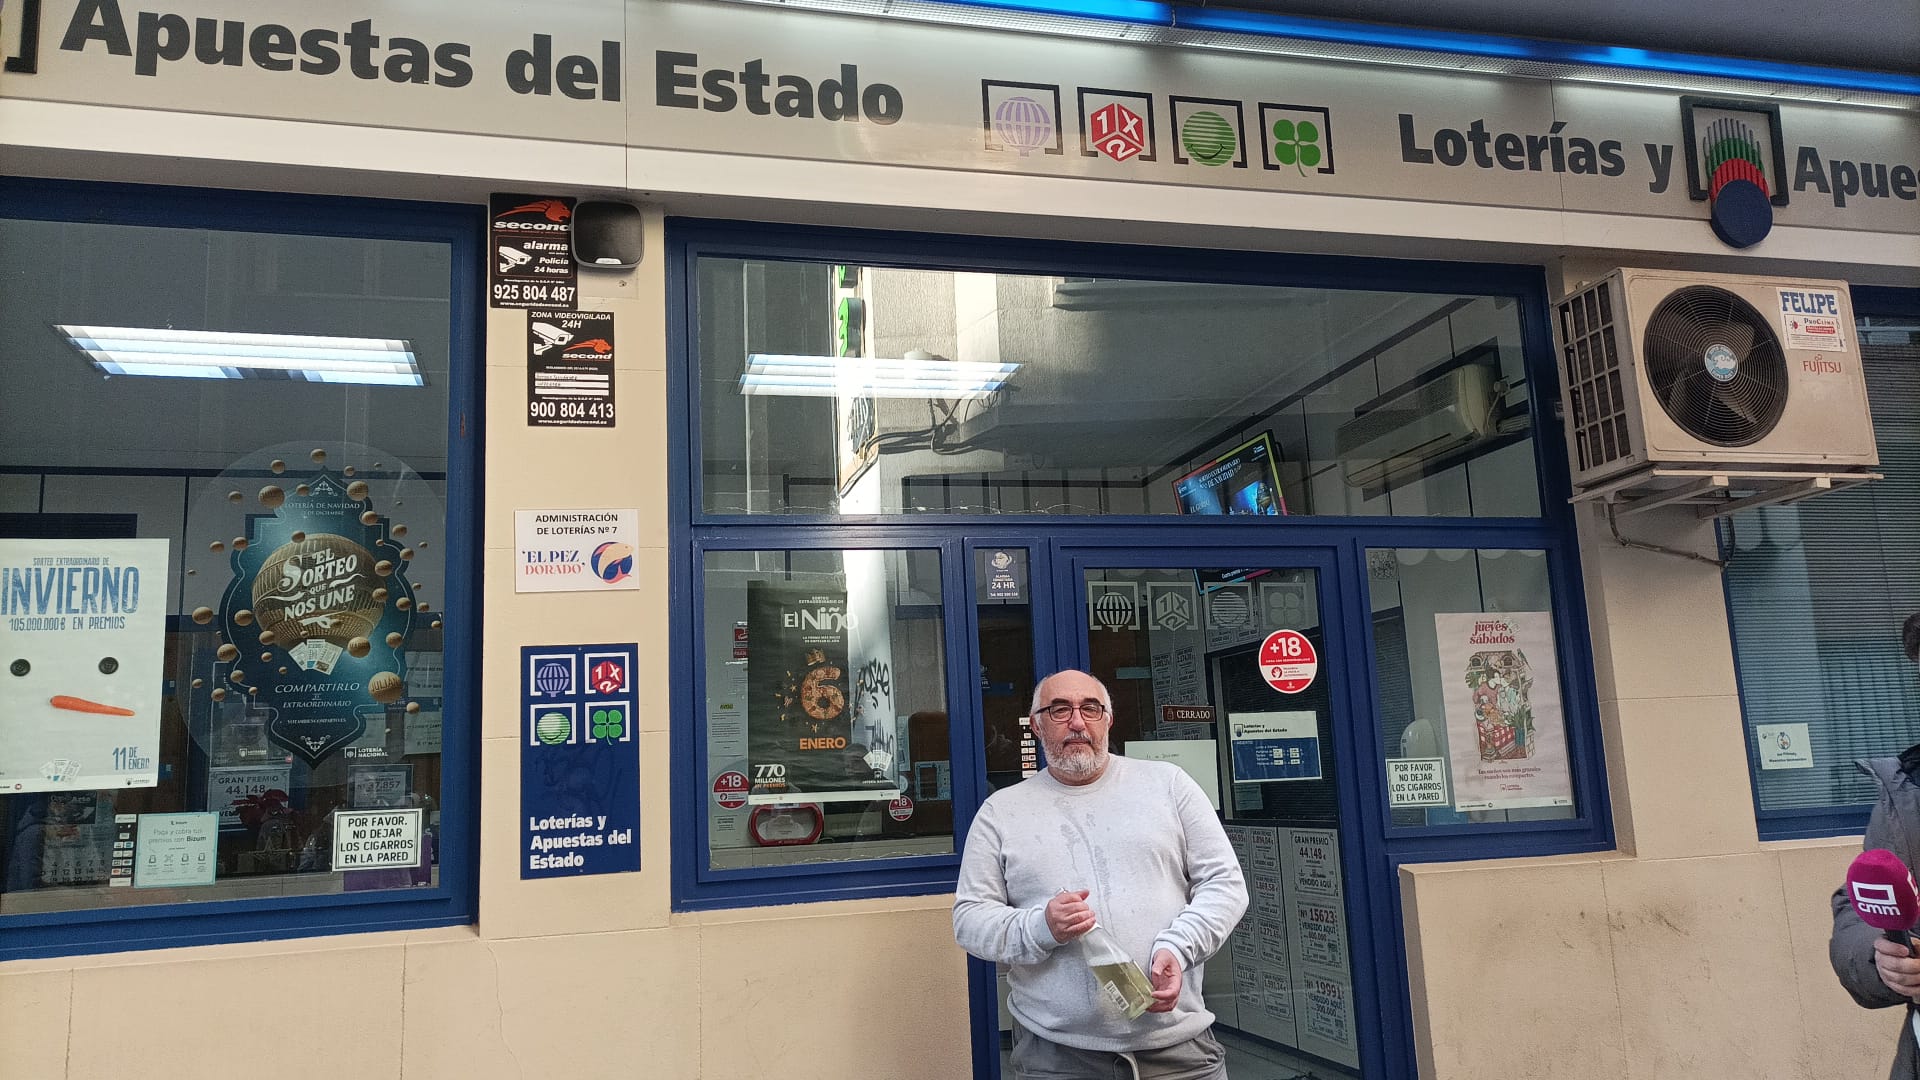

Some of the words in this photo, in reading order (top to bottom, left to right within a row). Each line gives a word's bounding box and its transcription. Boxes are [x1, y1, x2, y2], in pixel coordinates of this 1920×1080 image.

[60, 0, 474, 88] Apuestas
[504, 33, 622, 103] del
[655, 49, 904, 126] Estado
[1398, 112, 1626, 177] Loterías
[1643, 142, 1674, 194] y
[1793, 145, 1920, 209] Apue
[523, 240, 568, 251] alarma
[539, 256, 569, 265] Policía
[546, 266, 569, 274] horas
[494, 284, 519, 300] 925
[522, 285, 548, 301] 804
[550, 286, 576, 302] 487
[1779, 291, 1838, 315] FELIPE
[531, 311, 553, 319] ZONA
[554, 312, 611, 321] VIDEOVIGILADA
[561, 320, 582, 329] 24H
[1802, 360, 1842, 375] FUJITSU
[530, 402, 556, 417] 900
[560, 403, 586, 418] 804
[588, 403, 614, 418] 413
[535, 512, 618, 523] ADMINISTRACIÓN
[536, 527, 549, 535] DE
[551, 526, 595, 535] LOTERÍAS
[611, 526, 618, 534] 7
[311, 548, 335, 565] EL
[549, 550, 580, 562] PEZ
[277, 554, 358, 593] SORTEO
[1, 566, 139, 616] INVIERNO
[309, 582, 327, 595] QUE
[991, 581, 1001, 589] 24
[1003, 581, 1016, 589] HR
[284, 597, 316, 621] NOS
[319, 584, 355, 610] UNE
[72, 616, 84, 630] EN
[88, 616, 125, 630] PREMIOS
[801, 606, 859, 633] Niño
[1472, 620, 1508, 636] jueves
[1469, 632, 1515, 645] sábados
[1269, 636, 1302, 657] +18
[275, 682, 360, 693] COMPARTIRLO
[283, 701, 351, 709] EXTRAORDINARIO
[1176, 710, 1210, 719] CERRADO
[800, 737, 847, 749] ENERO
[112, 747, 126, 770] 11
[129, 747, 138, 758] DE
[754, 763, 786, 778] 770
[1394, 764, 1408, 772] POR
[218, 777, 244, 785] GRAN
[246, 776, 279, 784] PREMIO
[720, 775, 742, 788] +18
[1399, 774, 1409, 782] NO
[1410, 773, 1433, 782] DEJAR
[225, 784, 266, 795] 44.148
[1392, 784, 1406, 792] LOS
[1407, 782, 1442, 792] CIGARROS
[1396, 794, 1405, 802] EN
[1417, 792, 1440, 801] PARED
[348, 818, 368, 828] POR
[529, 813, 593, 831] Loterías
[597, 815, 607, 830] y
[353, 829, 366, 839] NO
[369, 828, 403, 839] DEJAR
[340, 842, 360, 852] LOS
[363, 839, 414, 851] CIGARROS
[530, 832, 603, 853] Apuestas
[607, 828, 632, 845] del
[1294, 835, 1311, 845] GRAN
[1310, 837, 1329, 846] PREMIO
[344, 854, 356, 864] EN
[360, 853, 373, 863] LA
[377, 851, 409, 862] PARED
[1299, 847, 1323, 860] 44.148
[529, 851, 585, 870] Estado
[1309, 907, 1335, 924] 15623
[1858, 902, 1901, 916] cmm
[1315, 980, 1342, 999] 19991
